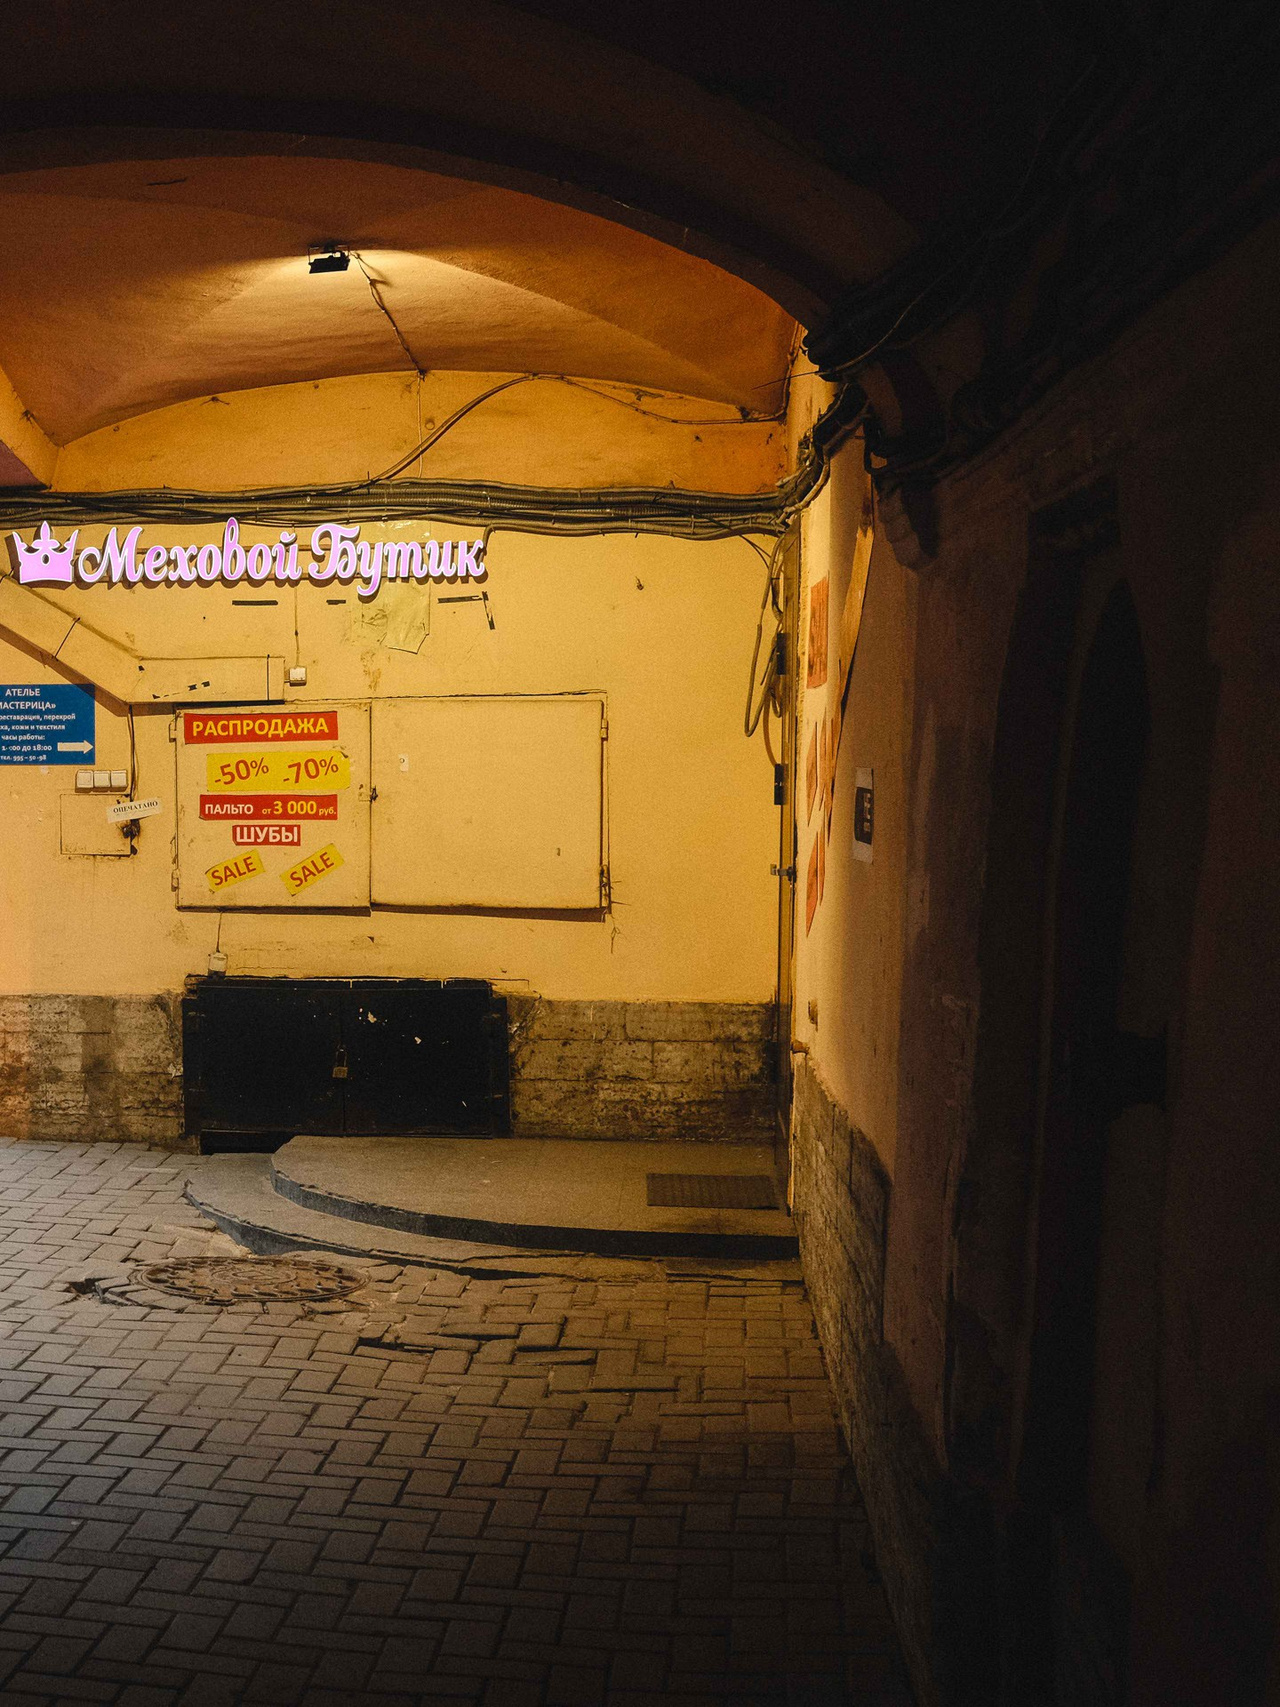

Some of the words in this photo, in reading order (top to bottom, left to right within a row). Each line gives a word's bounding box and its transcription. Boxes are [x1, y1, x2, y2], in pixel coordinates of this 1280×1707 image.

[78, 517, 301, 582] Меховой
[308, 523, 487, 597] Бутик
[5, 688, 41, 697] АТЕЛЬЕ
[43, 713, 76, 721] перекрой
[192, 717, 329, 738] РАСПРОДАЖА
[18, 733, 46, 742] работы:
[214, 757, 269, 785] -50%
[283, 756, 339, 784] -70%
[113, 800, 158, 813] ОПЕЧАТАНО
[205, 804, 254, 815] ПАЛЬТО
[273, 801, 283, 815] 3
[287, 801, 317, 815] 000
[318, 806, 337, 816] руб.
[236, 826, 299, 843] ШУБЫ
[211, 856, 257, 887] SALE
[290, 851, 335, 887] SALE
